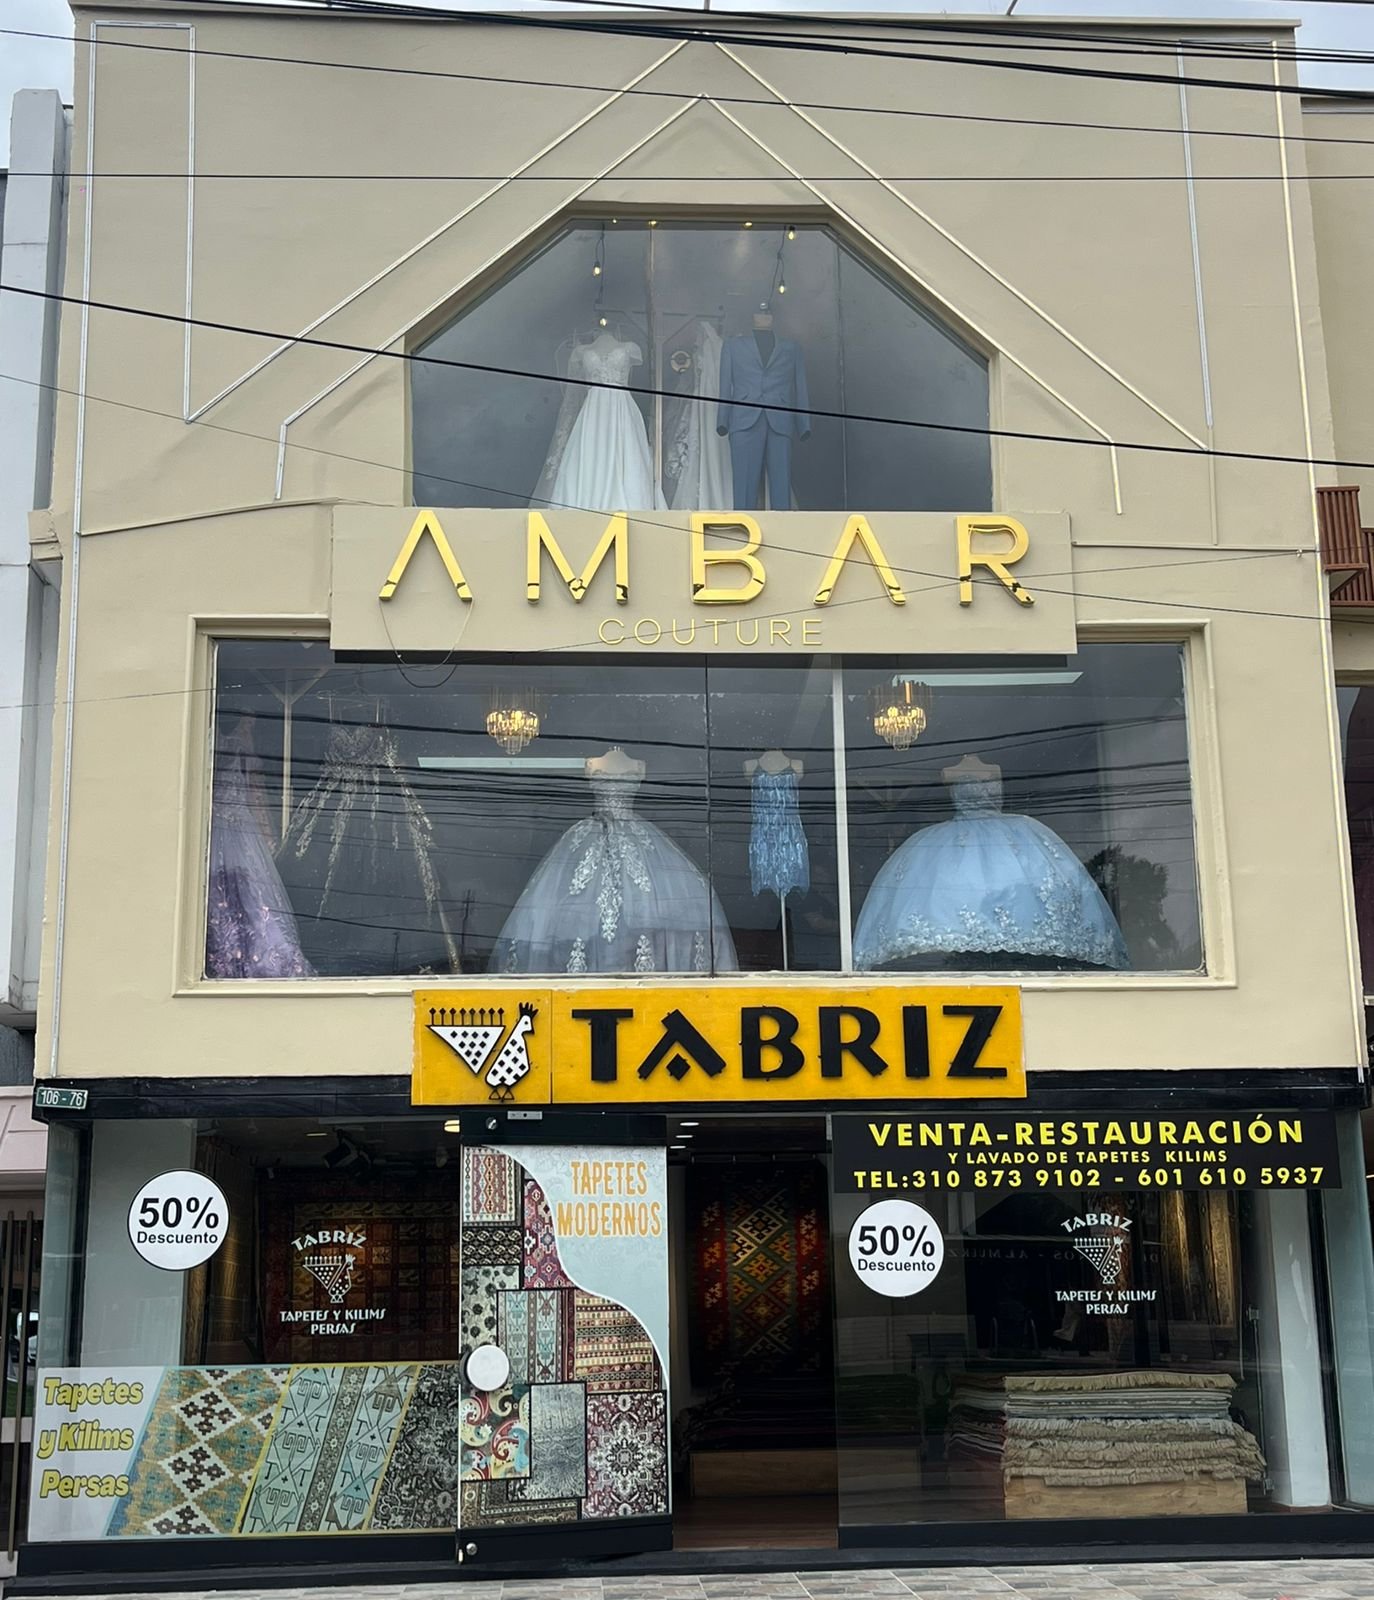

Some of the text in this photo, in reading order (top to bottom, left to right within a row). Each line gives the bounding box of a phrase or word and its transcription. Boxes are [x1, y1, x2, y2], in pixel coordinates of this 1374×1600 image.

[378, 509, 1035, 607] AMBAR
[598, 617, 824, 646] COUTURE
[571, 1004, 1009, 1083] TABRIZ
[41, 1090, 60, 1105] 106
[70, 1091, 83, 1106] 76
[868, 1114, 1303, 1147] VENTA-RESTAURACIÓN
[948, 1150, 1228, 1164] Y LAVADO DE TAPETES KILIMS
[570, 1160, 648, 1196] TAPETES
[854, 1170, 960, 1188] TEL:310
[974, 1170, 1022, 1188] 873
[1035, 1169, 1101, 1187] 9102
[1138, 1168, 1183, 1187] 601
[1199, 1167, 1247, 1186] 610
[1260, 1167, 1324, 1185] 5937
[138, 1196, 219, 1229] 50%
[556, 1202, 661, 1237] MODERNOS
[1060, 1213, 1133, 1233] TABRIZ
[137, 1231, 218, 1245] Descuento
[291, 1230, 367, 1251] TABRIZ
[857, 1225, 936, 1257] 50%
[857, 1259, 936, 1273] Descuento
[1055, 1290, 1157, 1301] TAPETES Y KILIMS
[280, 1308, 386, 1322] TAPETES Y KILIMS
[1086, 1303, 1129, 1315] PERSAS
[311, 1322, 356, 1335] PERSAS
[44, 1377, 143, 1411] Tapetes
[37, 1420, 134, 1459] y Kilims
[39, 1469, 130, 1498] Persas
